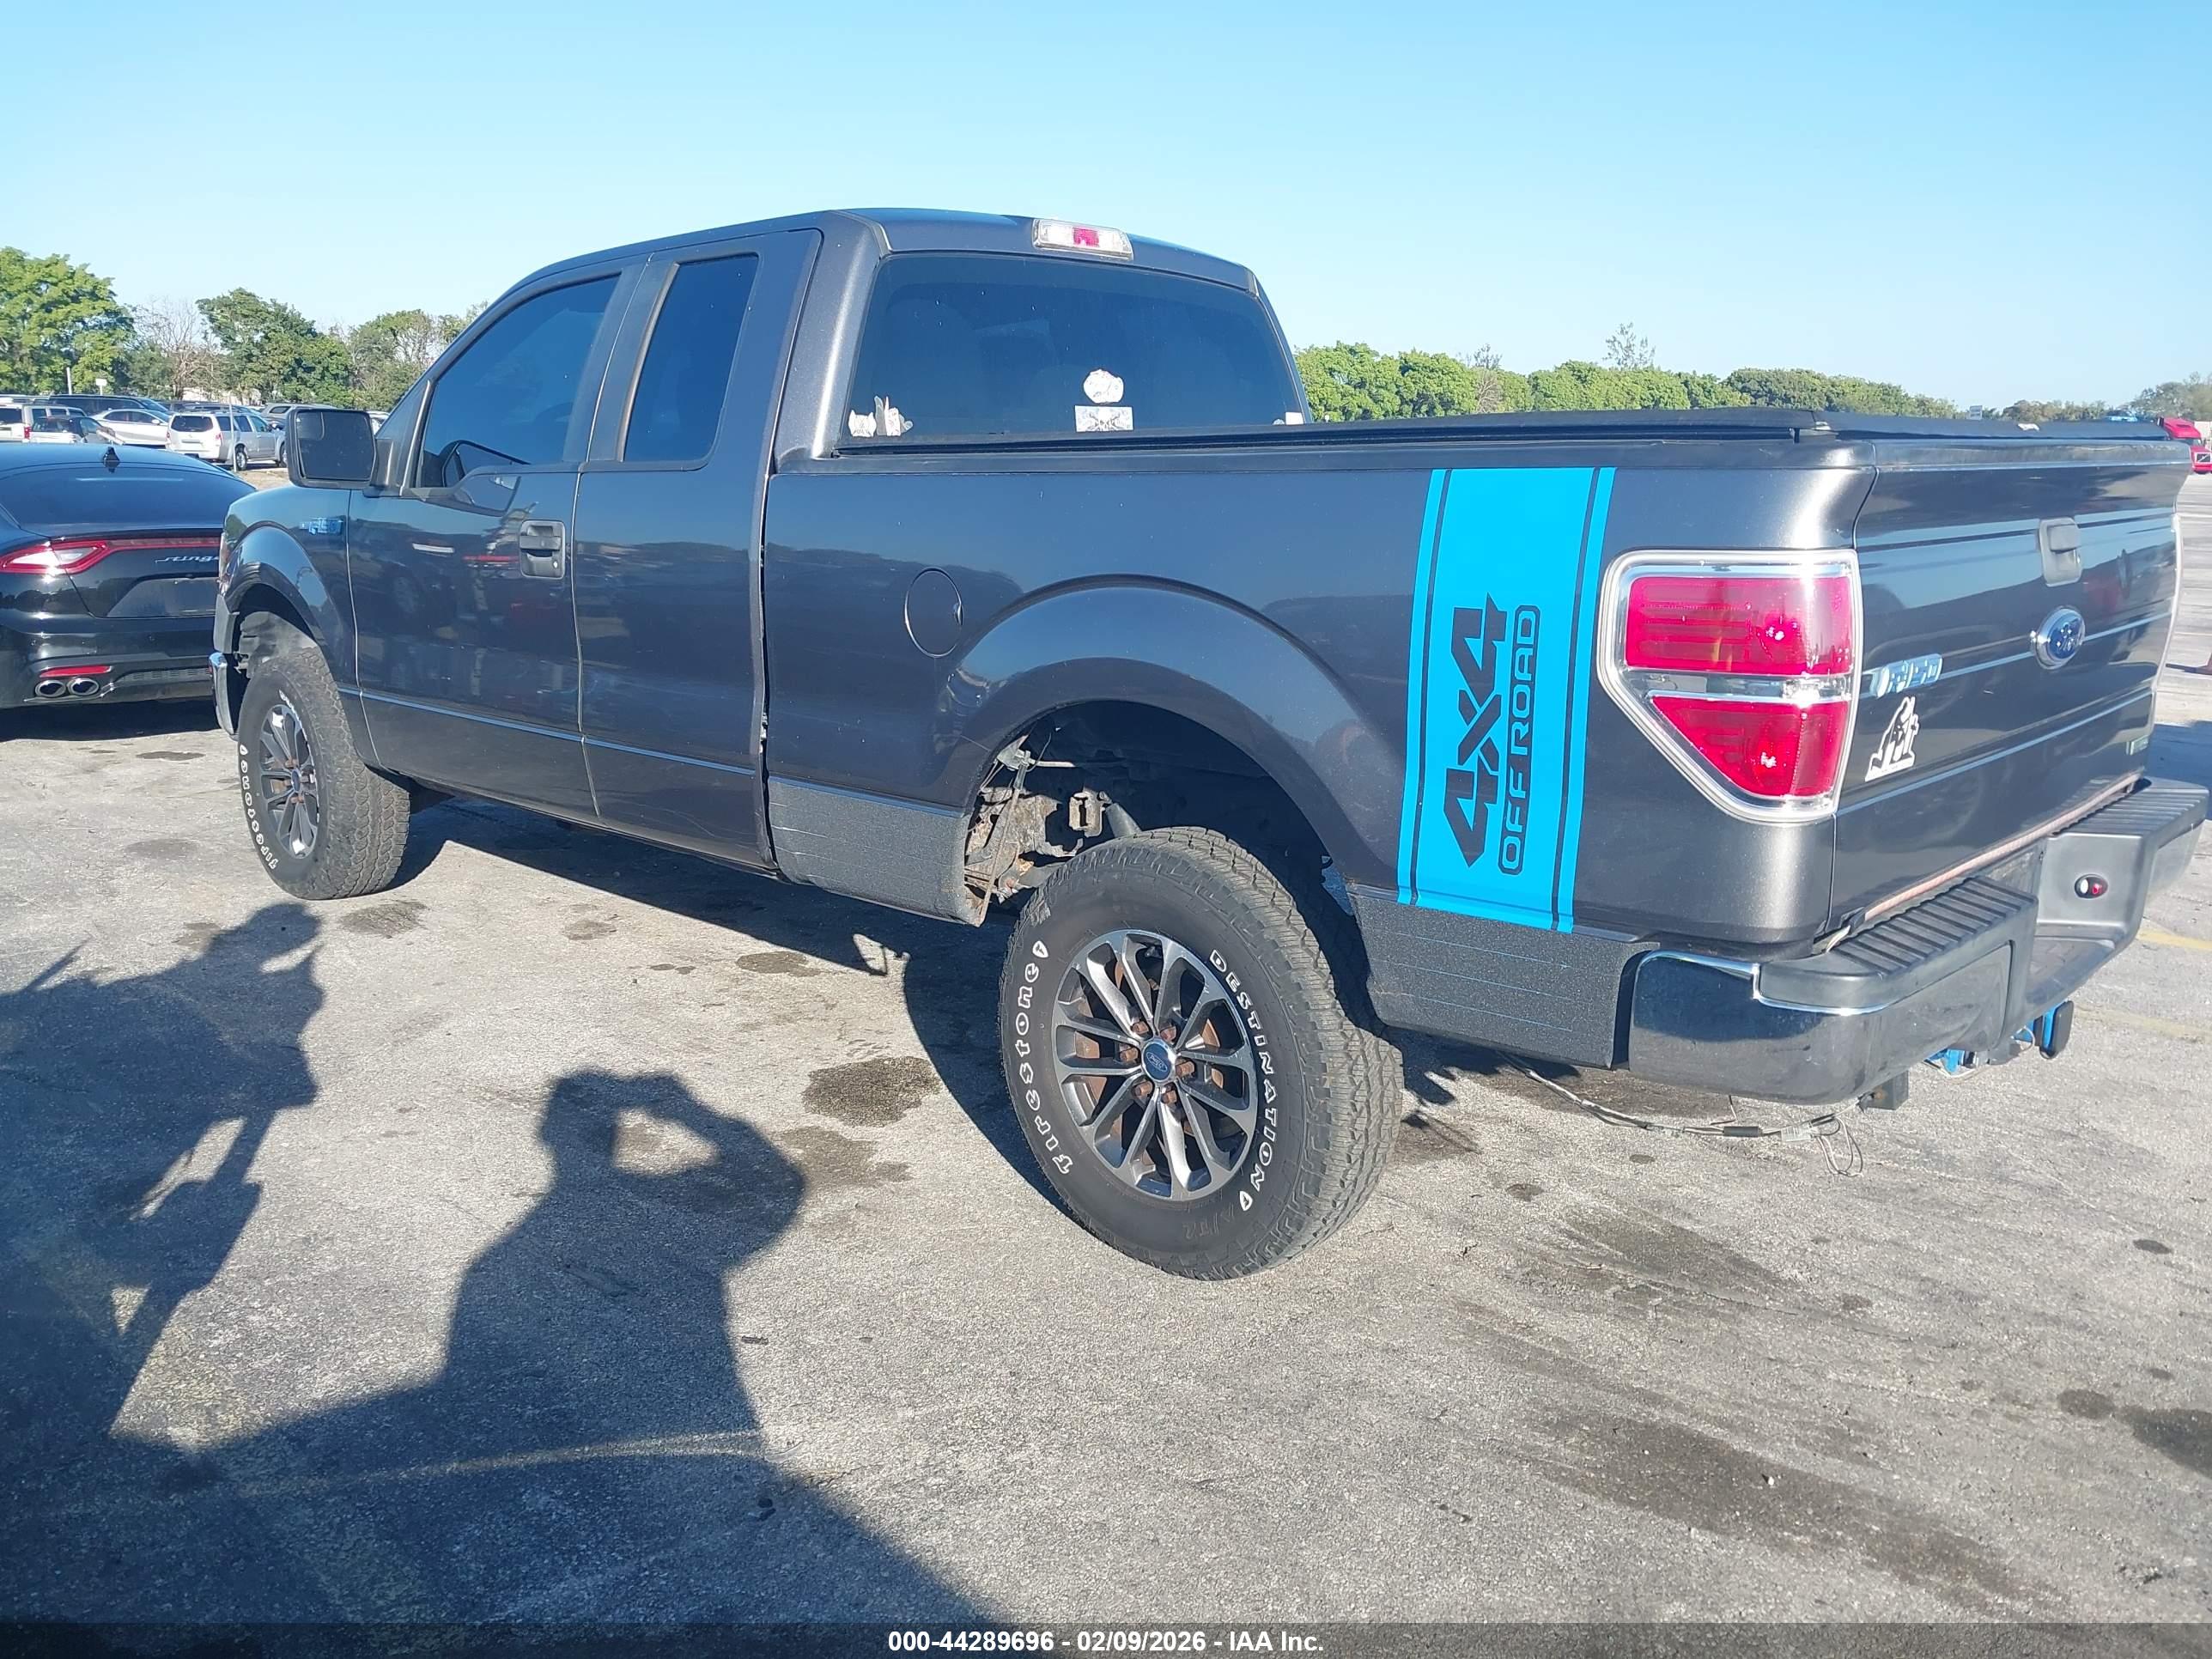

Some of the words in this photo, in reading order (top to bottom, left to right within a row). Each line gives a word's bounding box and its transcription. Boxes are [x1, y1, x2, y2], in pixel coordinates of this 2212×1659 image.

[1510, 610, 1536, 757] ROAD
[1502, 765, 1529, 871] OFF
[1015, 962, 1073, 1176] Firestone
[1209, 949, 1279, 1192] DESTINATION
